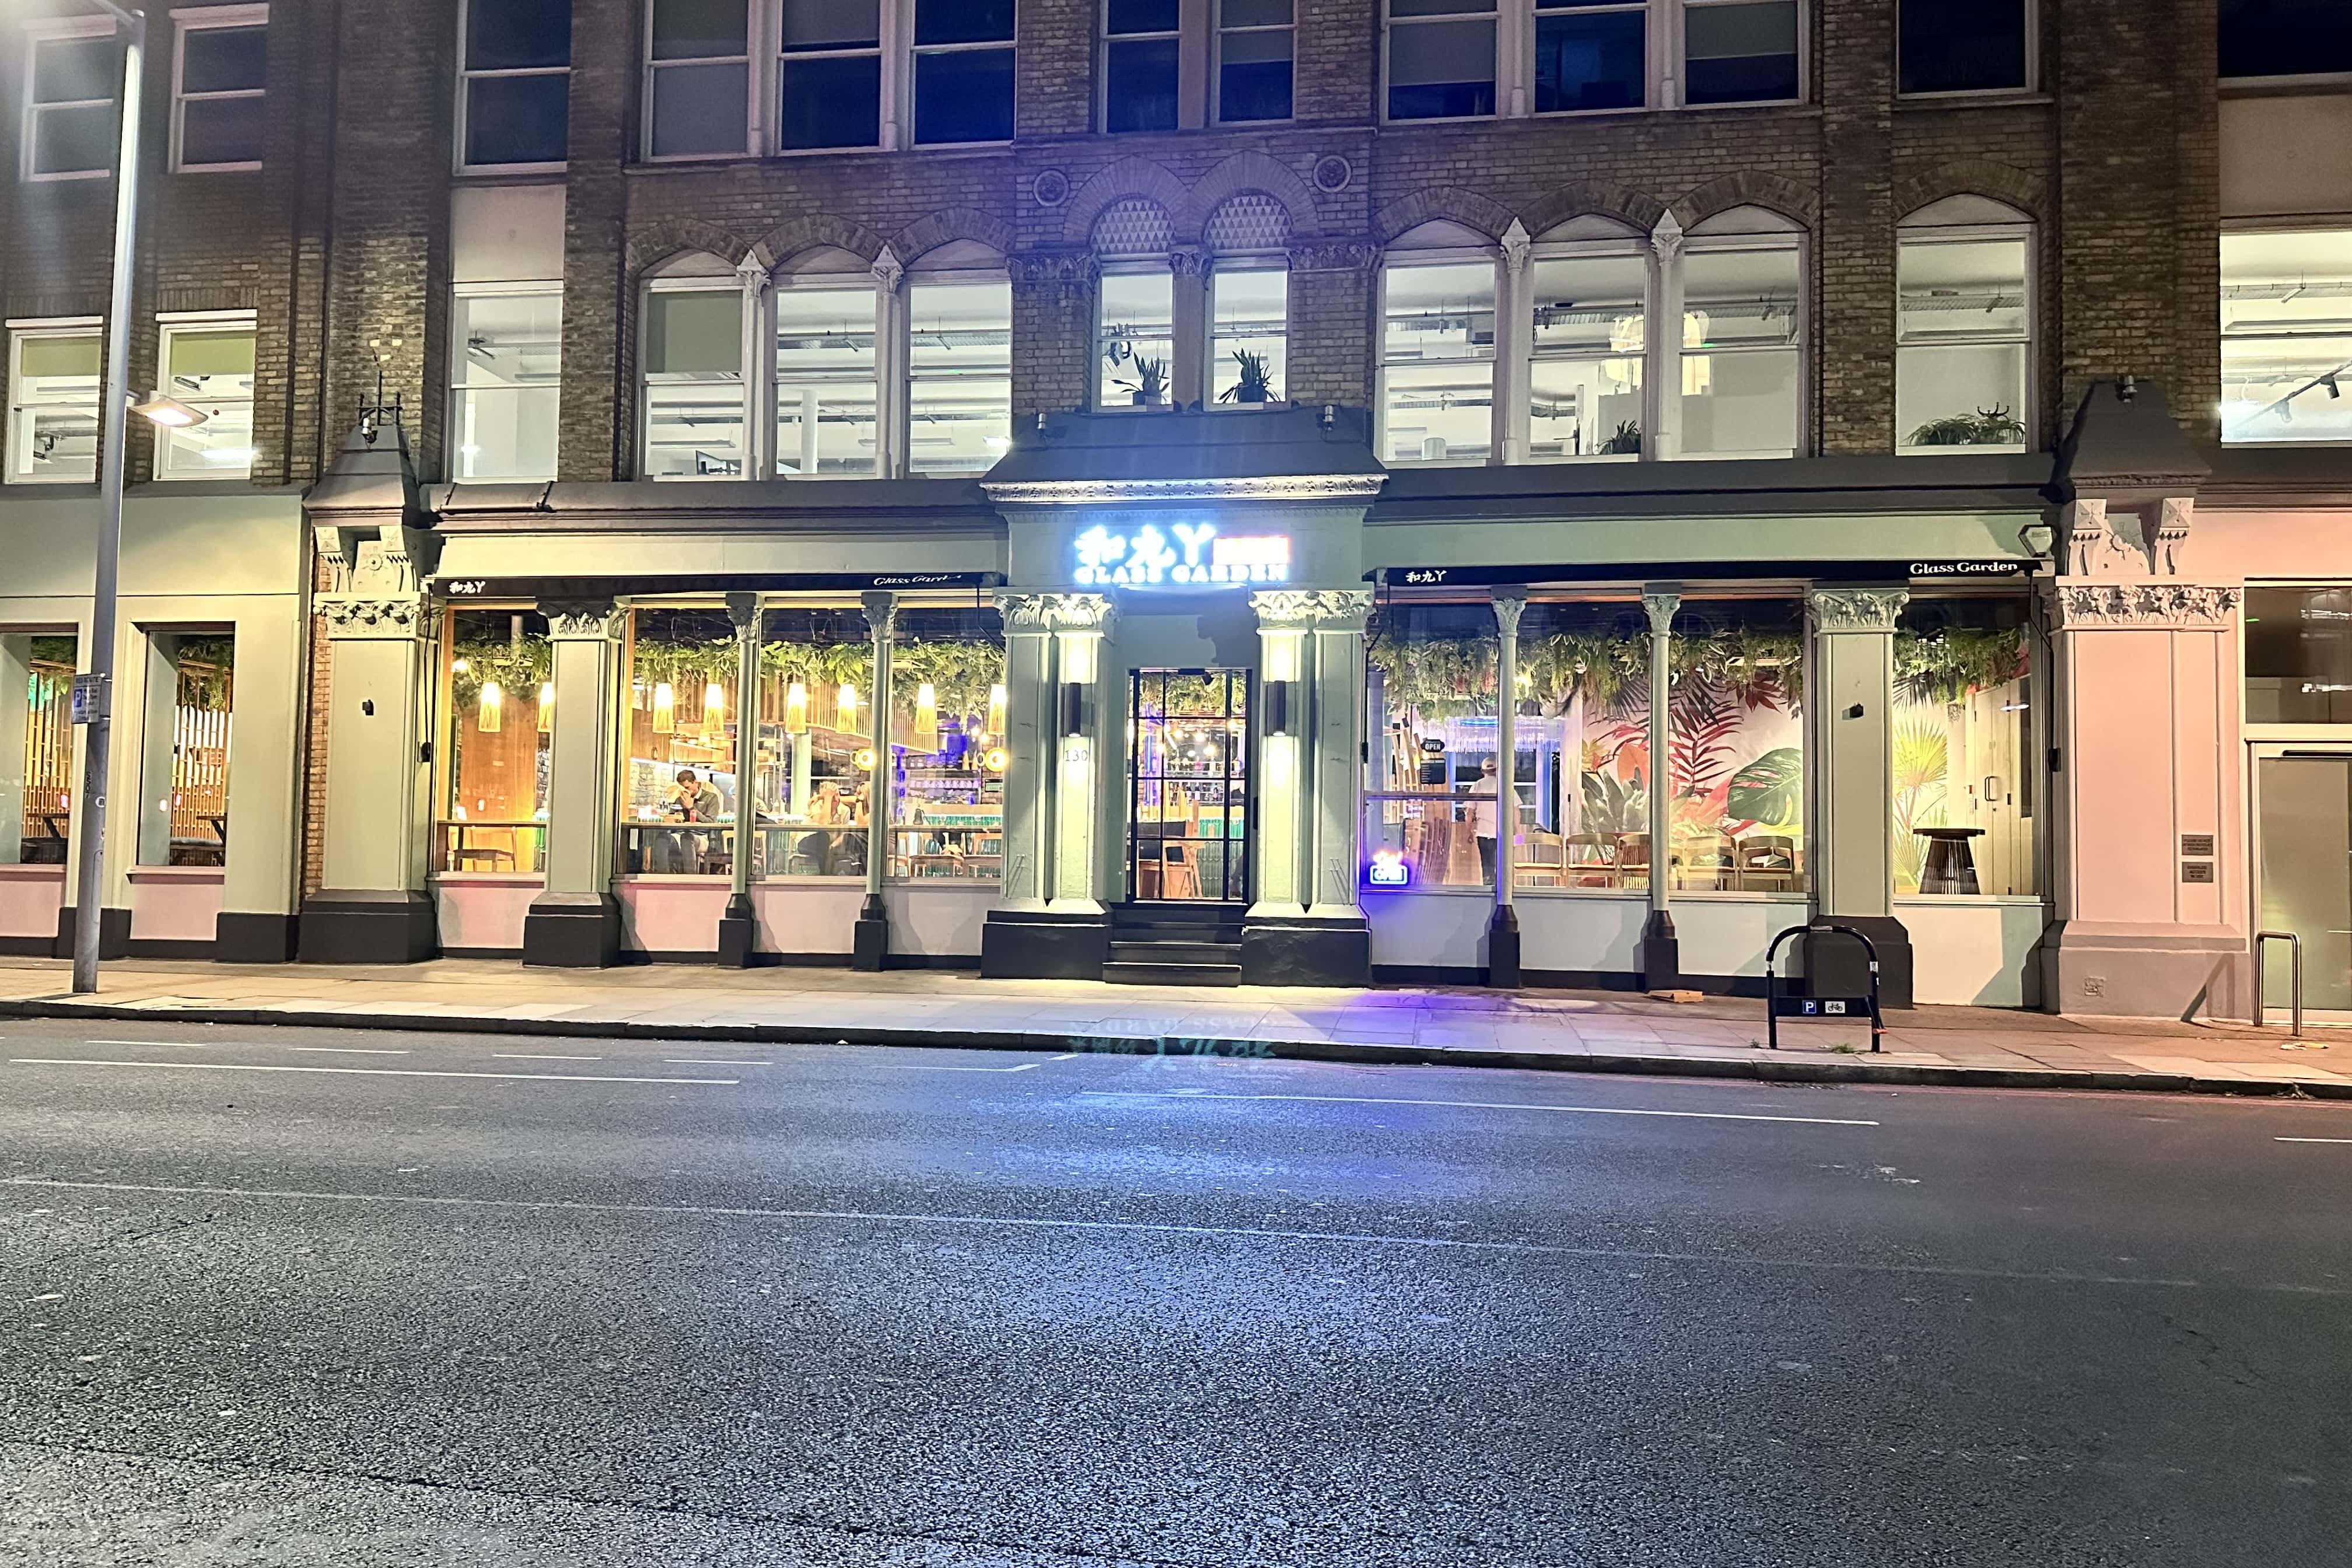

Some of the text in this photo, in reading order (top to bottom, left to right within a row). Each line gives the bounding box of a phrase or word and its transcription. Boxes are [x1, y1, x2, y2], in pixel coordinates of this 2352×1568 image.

[1910, 562, 2018, 574] Glass Garden
[874, 577, 910, 586] Glass
[1065, 750, 1088, 761] 130
[1806, 1002, 1814, 1012] P
